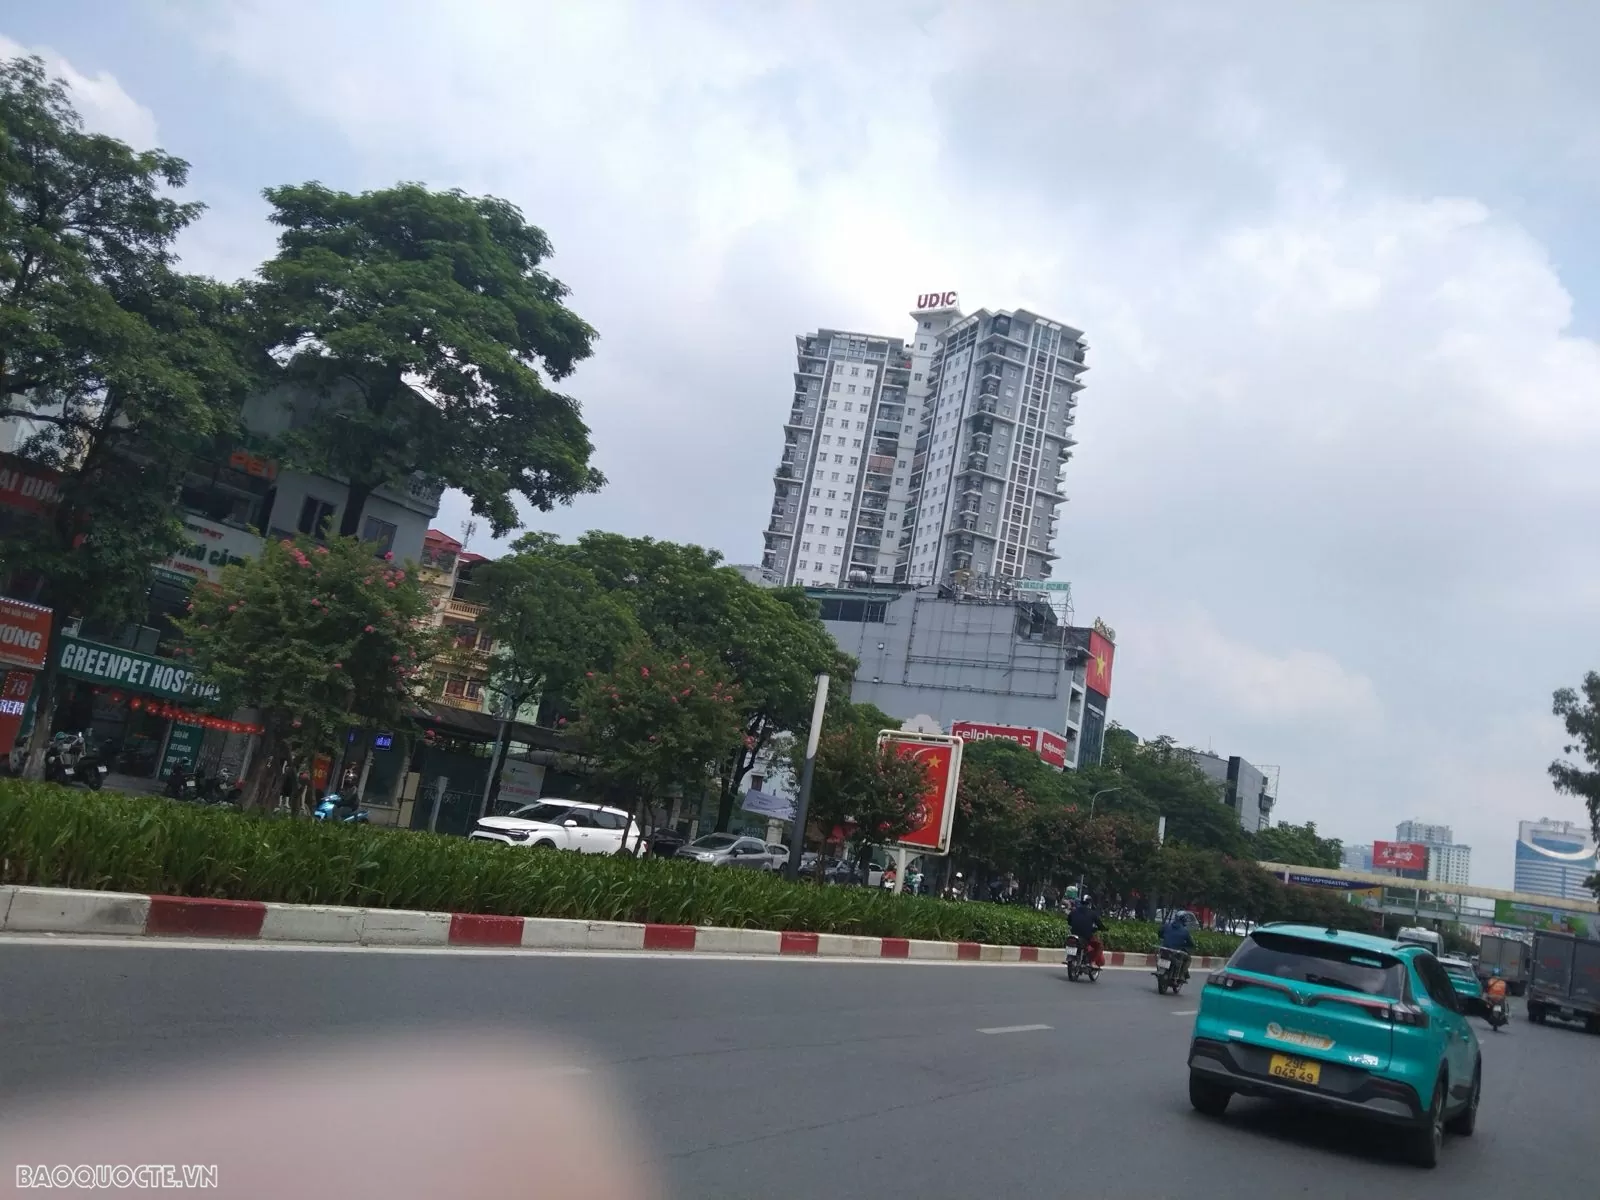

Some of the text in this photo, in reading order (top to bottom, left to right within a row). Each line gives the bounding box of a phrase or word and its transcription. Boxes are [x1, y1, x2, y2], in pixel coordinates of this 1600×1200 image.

[917, 291, 957, 309] UDIC
[60, 643, 152, 685] GREENPET
[1273, 1064, 1315, 1082] 045.49
